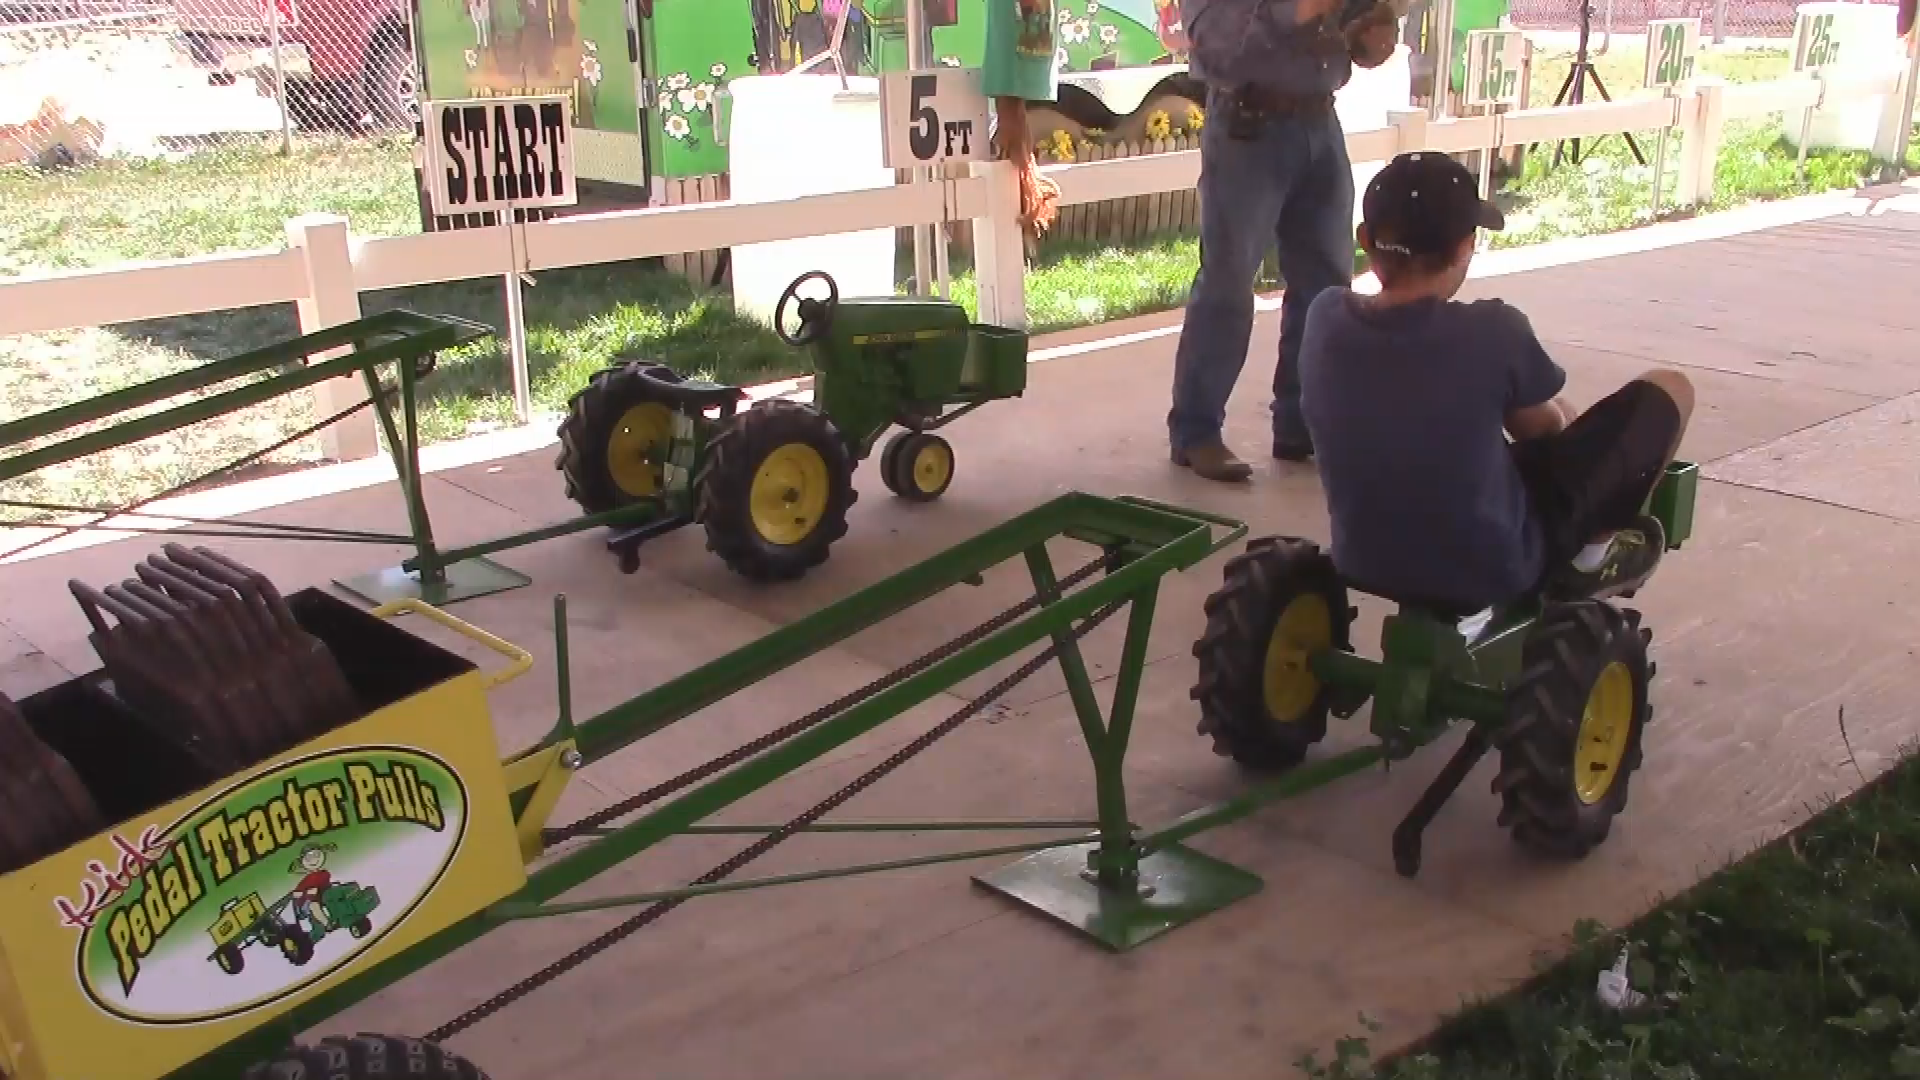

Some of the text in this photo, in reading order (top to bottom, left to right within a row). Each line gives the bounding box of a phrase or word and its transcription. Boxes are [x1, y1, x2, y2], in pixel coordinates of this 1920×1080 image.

[1479, 35, 1517, 100] 15 FT
[1656, 24, 1685, 86] 20
[1806, 14, 1833, 67] 25
[442, 103, 565, 205] START
[910, 75, 972, 160] 5 FT
[106, 760, 445, 998] Pedal Tractor Pulls
